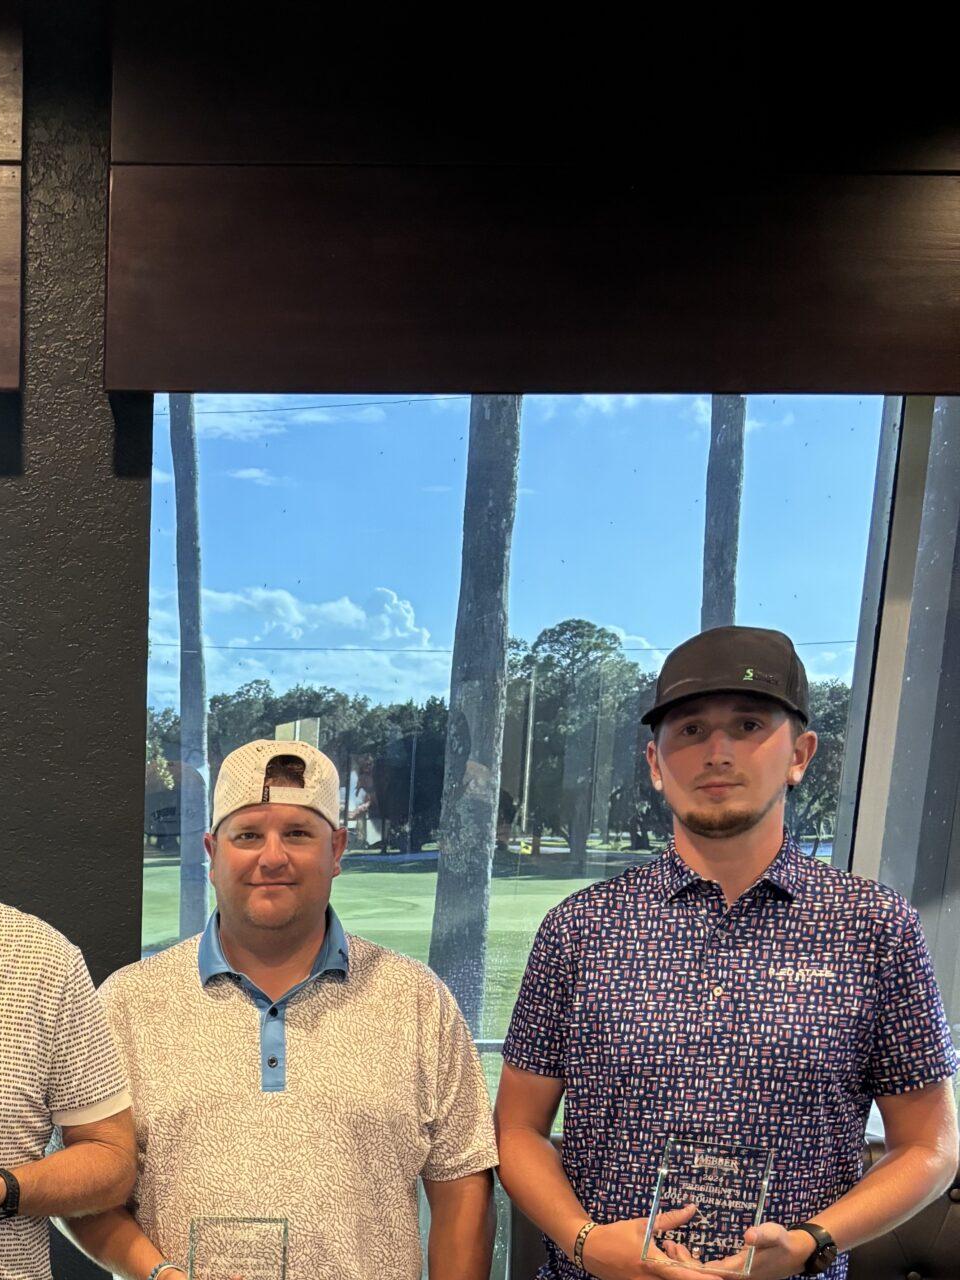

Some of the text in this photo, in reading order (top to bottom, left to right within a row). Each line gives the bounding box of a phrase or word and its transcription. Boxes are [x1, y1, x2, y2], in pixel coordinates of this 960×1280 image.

[695, 1154, 738, 1170] WEBBER
[703, 1174, 724, 1183] 2024
[664, 1191, 688, 1201] GOLF
[656, 1229, 745, 1248] 1ST PLACE
